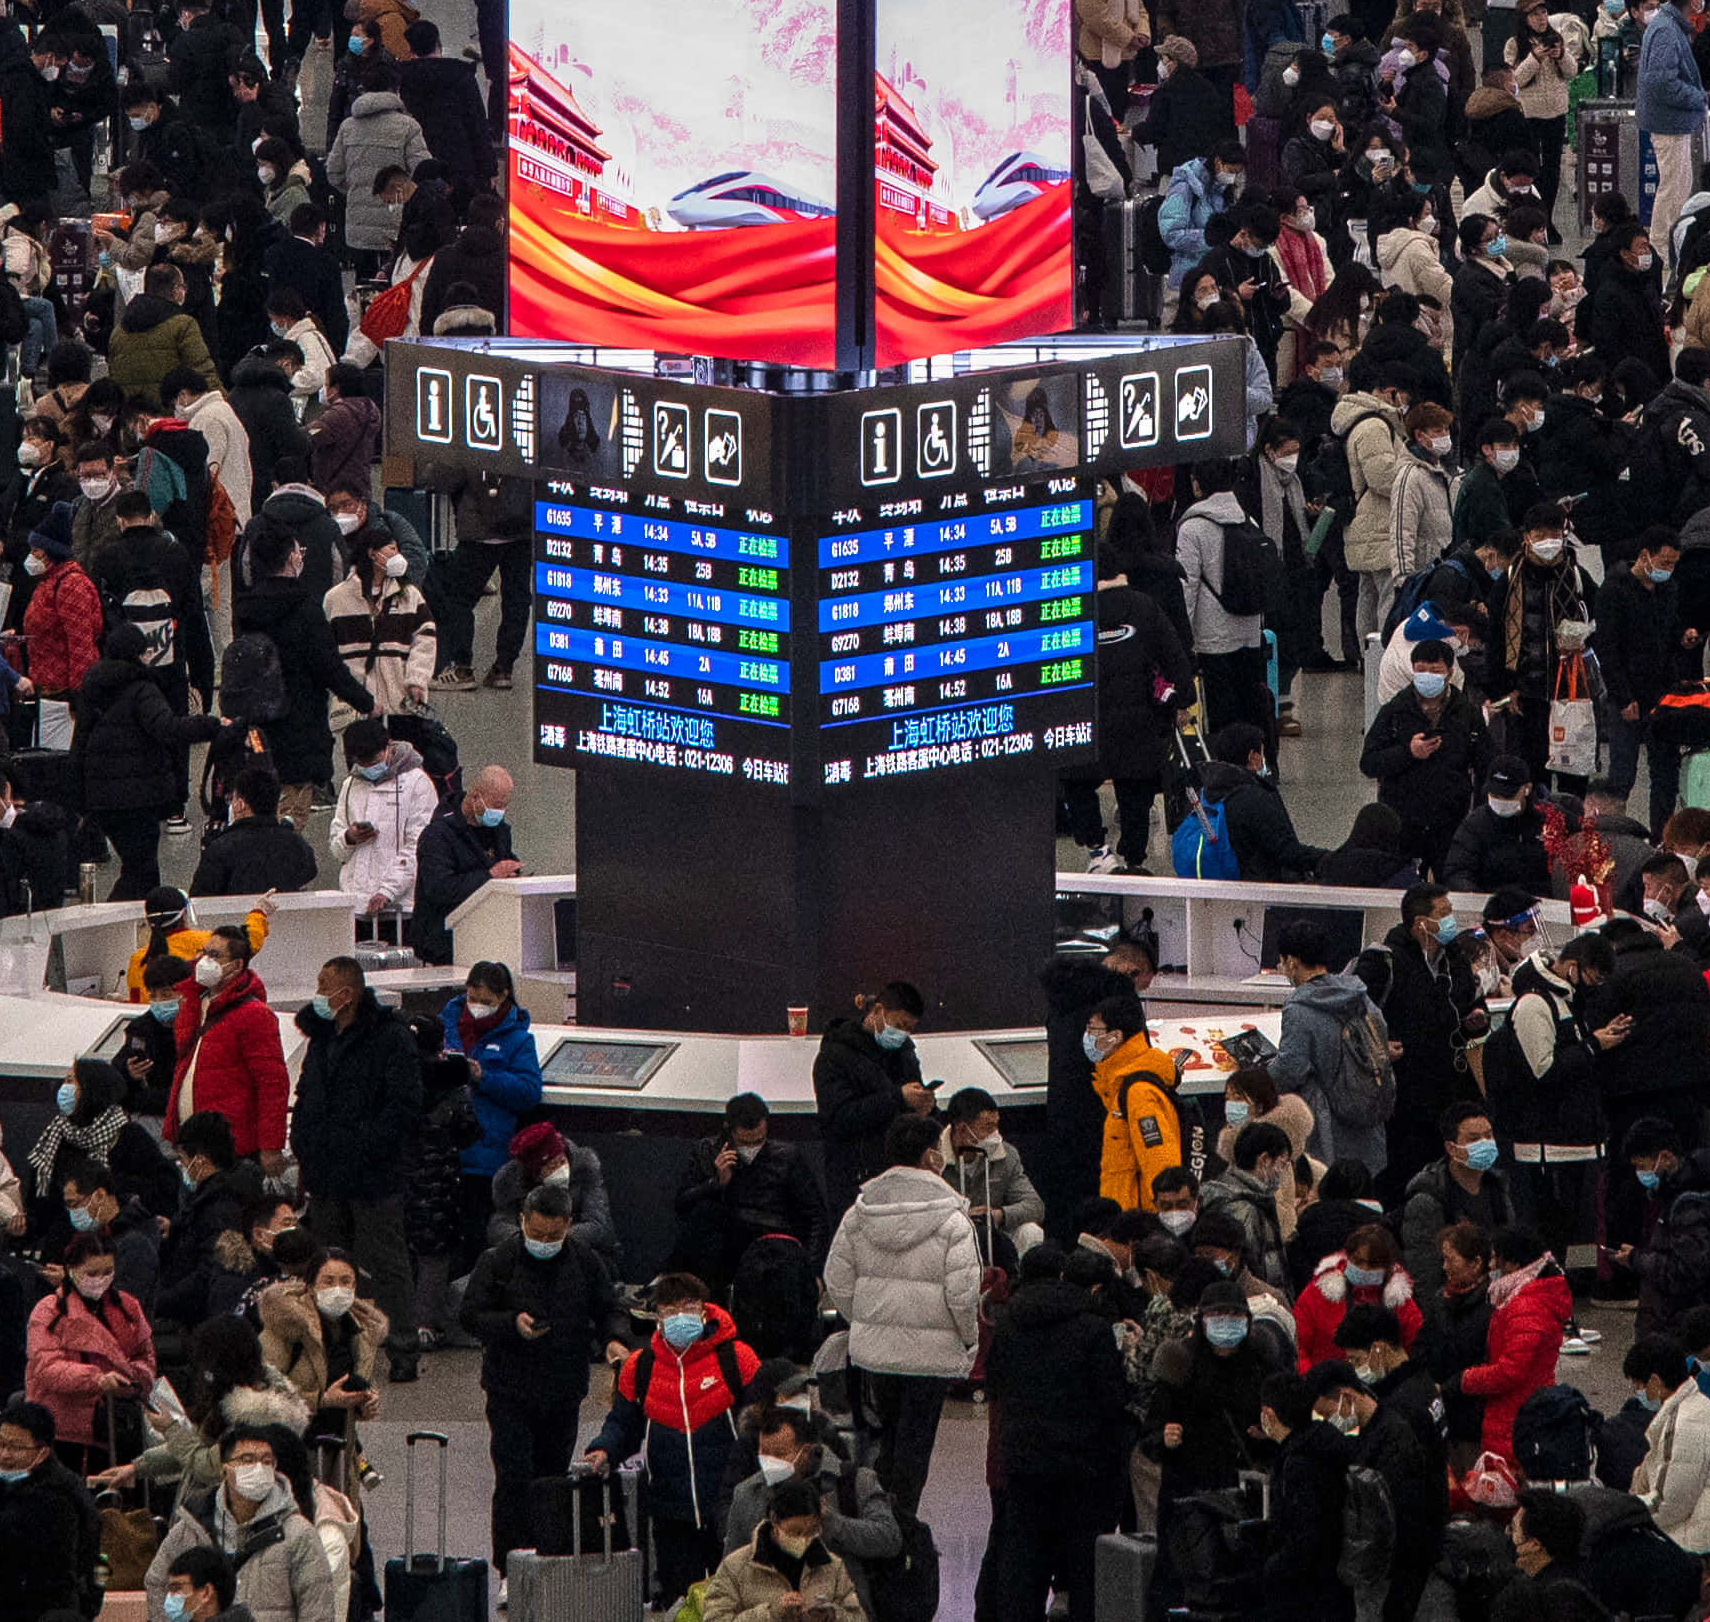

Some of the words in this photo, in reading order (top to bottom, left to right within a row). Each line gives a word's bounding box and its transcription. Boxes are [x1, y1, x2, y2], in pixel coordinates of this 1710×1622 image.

[832, 539, 859, 558] G1635
[939, 524, 966, 541] 14:34
[1041, 504, 1081, 528] 正在检票
[832, 571, 859, 590] D2132
[939, 555, 966, 573] 14:35
[995, 548, 1012, 565] 25B
[1041, 535, 1082, 559] 正在检票
[832, 602, 859, 620] G1818
[939, 586, 966, 604] 14:33
[1041, 566, 1081, 590] 正在检票
[832, 633, 859, 653] G9270
[939, 617, 966, 636] 14:38
[1041, 597, 1082, 621] 正在检票
[834, 665, 856, 683] D381
[939, 649, 966, 666] 14:45
[997, 642, 1010, 658] 2A
[1041, 628, 1081, 651] 正在检票
[832, 697, 860, 716] G7168
[939, 680, 966, 699] 14:52
[996, 673, 1012, 691] 16A
[1041, 659, 1082, 684] 正在检票
[598, 703, 715, 749] 上海虹桥站欢迎您
[888, 703, 1014, 750] 上海虹桥站欢迎您
